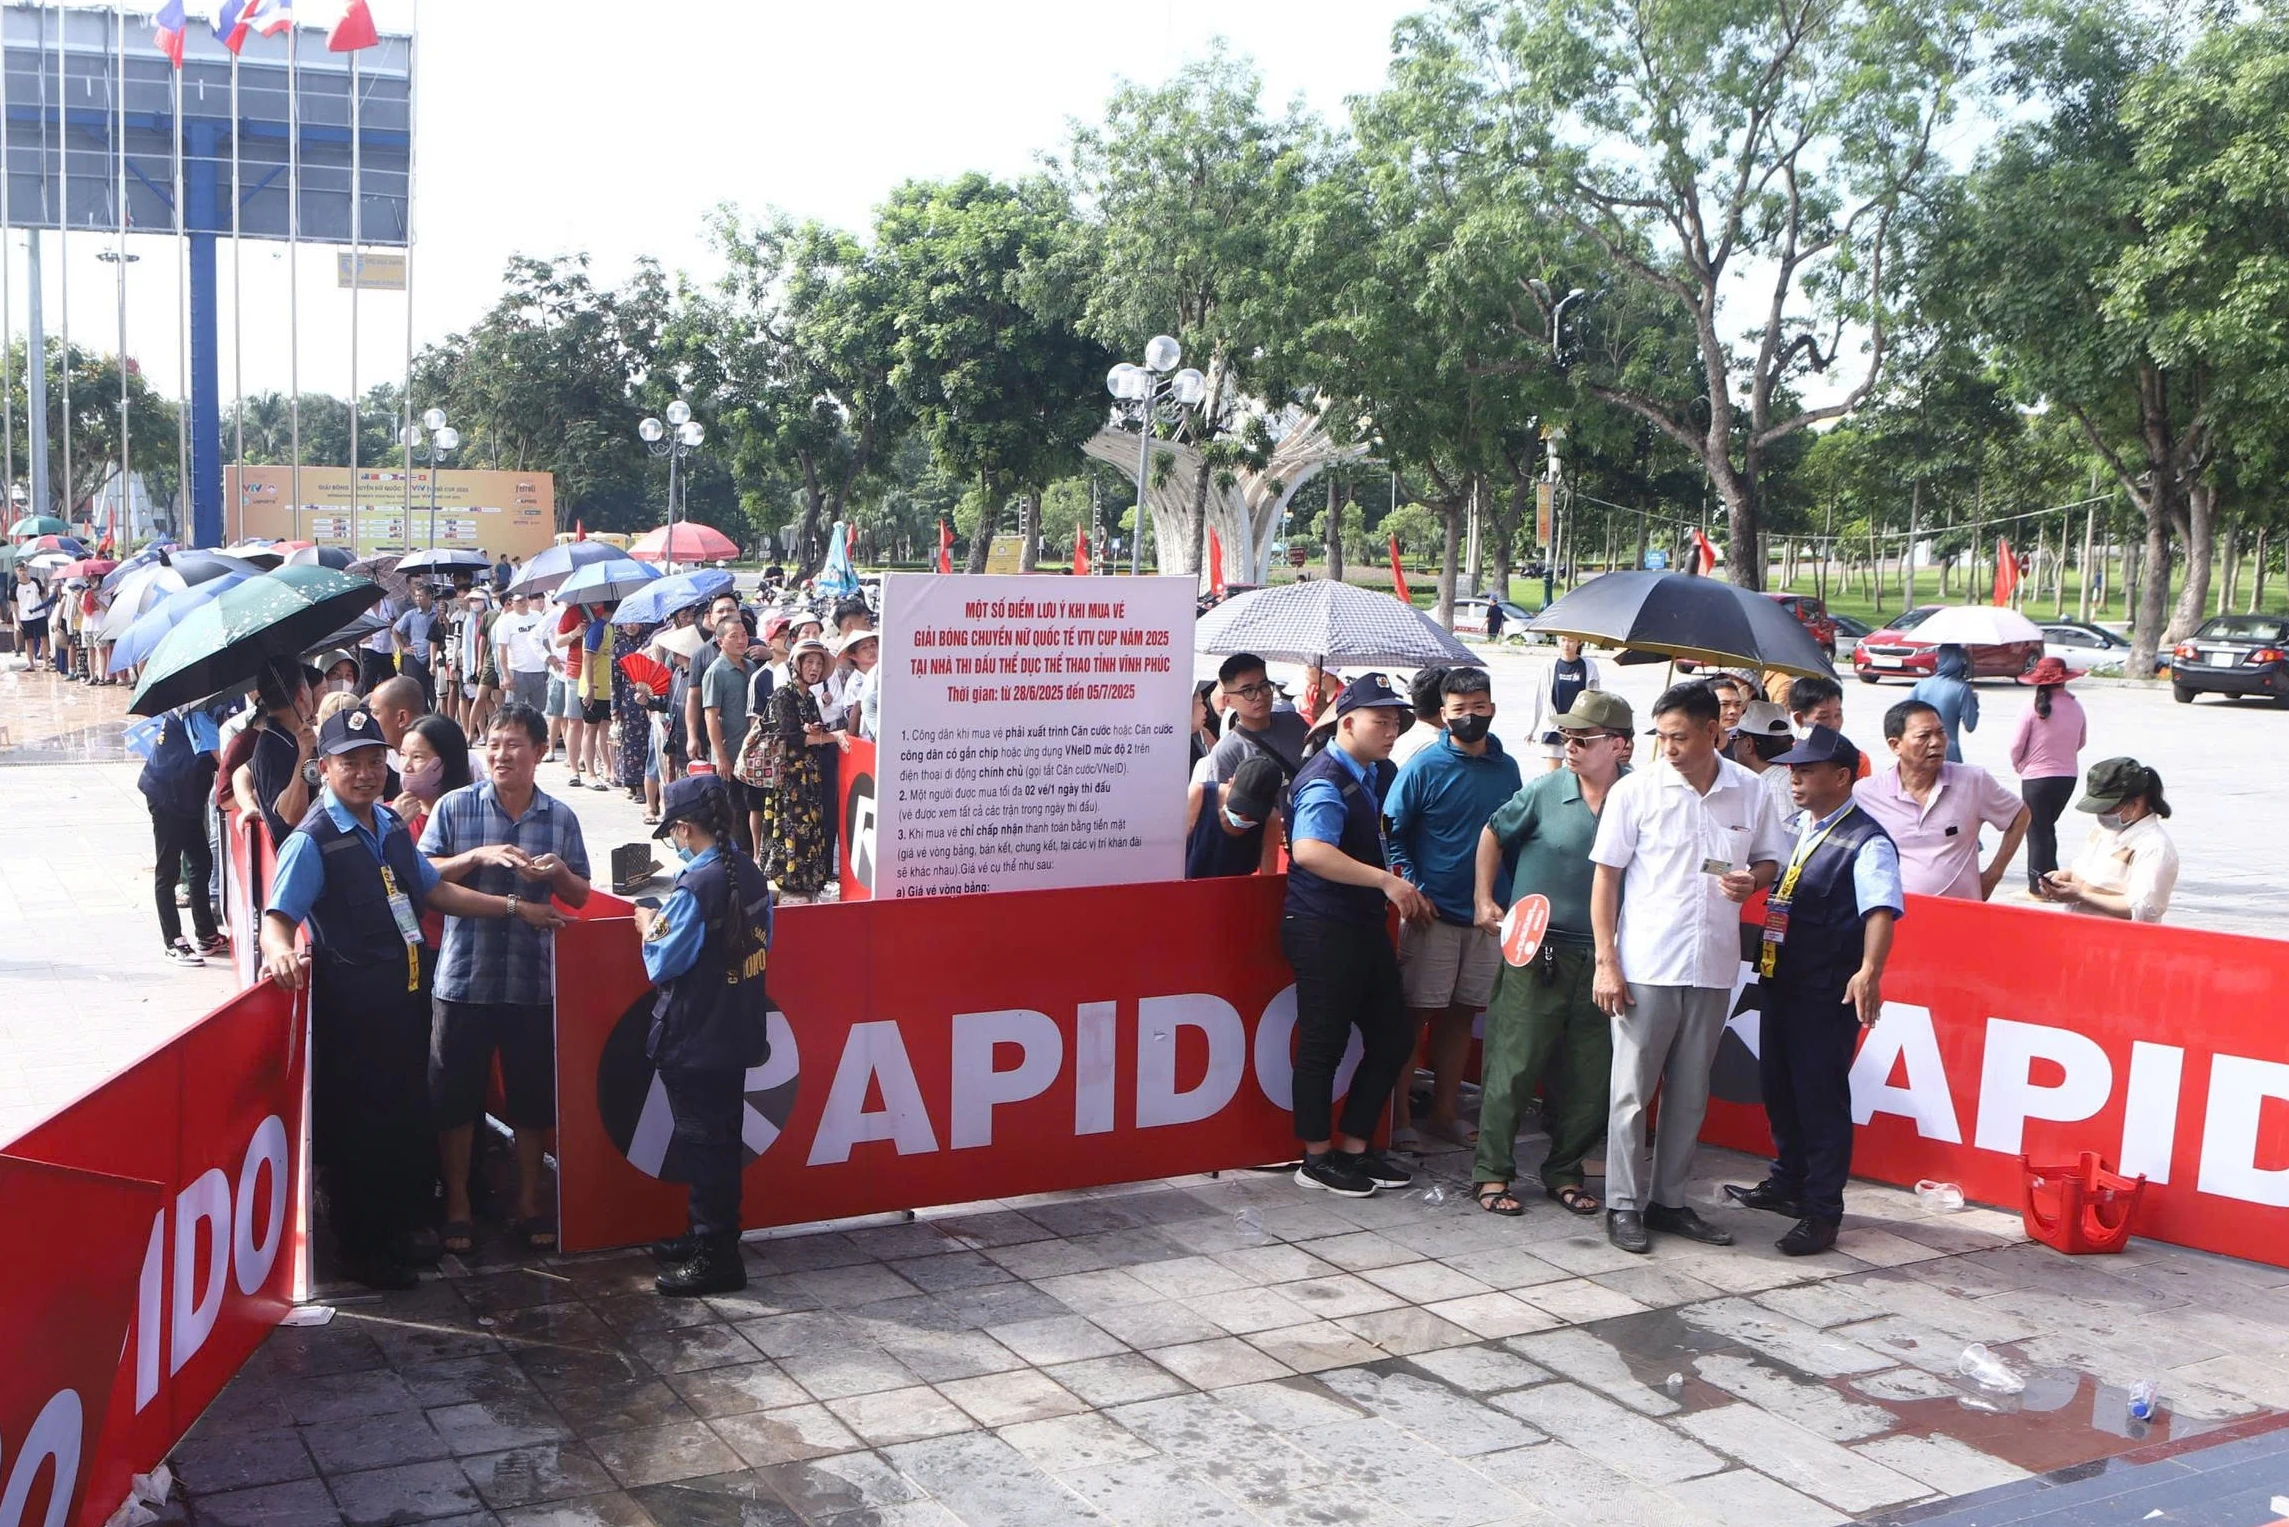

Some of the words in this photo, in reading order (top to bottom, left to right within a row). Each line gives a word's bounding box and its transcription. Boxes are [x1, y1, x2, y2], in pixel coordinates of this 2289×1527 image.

[965, 599, 988, 621] MỘT
[991, 596, 1006, 618] SỐ
[1008, 596, 1034, 618] ĐIỂM
[1037, 601, 1056, 618] LƯU
[1060, 600, 1066, 618] Ý
[1068, 603, 1085, 618] KHI
[1088, 603, 1110, 618] MUA
[1113, 600, 1125, 619] VÉ
[914, 625, 936, 647] GIẢI
[939, 627, 968, 646] BÓNG
[1015, 627, 1031, 646] NỮ
[1033, 625, 1060, 647] QUỐC
[1063, 625, 1076, 646] TẾ
[1077, 630, 1095, 646] VTV
[1097, 630, 1117, 646] CUP
[1120, 627, 1143, 646] NĂM
[1145, 630, 1169, 646] 2025
[911, 659, 927, 679] TẠI
[930, 655, 952, 674] NHÀ
[956, 658, 971, 674] THI
[975, 652, 996, 674] ĐẤU
[999, 651, 1017, 673] THỂ
[1021, 658, 1041, 677] DỤC
[1044, 651, 1063, 673] THỂ
[1066, 657, 1090, 673] THAO
[1094, 652, 1116, 673] TỈNH
[1119, 654, 1141, 672] VĨNH
[1144, 654, 1170, 672] PHÚC
[947, 685, 969, 702] Thời
[972, 685, 998, 703] gian:
[1001, 685, 1011, 701] từ
[1013, 685, 1063, 701] 28/6/2025
[1066, 681, 1084, 700] đến
[1087, 684, 1135, 700] 05/7/2025
[901, 730, 909, 741] 1.
[912, 729, 935, 743] Công
[938, 728, 954, 740] dân
[957, 728, 969, 739] khi
[972, 730, 990, 739] mua
[993, 728, 1003, 738] vé
[1005, 725, 1024, 740] phải
[1027, 725, 1046, 738] xuất
[1048, 726, 1068, 737] trình
[1071, 725, 1088, 736] Căn
[1090, 725, 1111, 736] cước
[1113, 725, 1132, 737] hoặc
[1134, 724, 1151, 735] Căn
[1154, 724, 1173, 734] cước
[901, 750, 923, 763] công
[926, 749, 943, 760] dân
[946, 748, 957, 759] có
[960, 746, 976, 761] gắn
[979, 747, 998, 760] chip
[1001, 747, 1021, 759] hoặc
[1024, 746, 1039, 759] ứng
[1042, 746, 1062, 759] dụng
[1065, 745, 1091, 755] VNeID
[1094, 743, 1112, 755] mức
[1114, 743, 1125, 756] độ
[1127, 744, 1132, 754] 2
[1134, 743, 1150, 754] trên
[900, 770, 918, 781] điện
[921, 769, 942, 780] thoại
[945, 768, 952, 779] di
[955, 768, 976, 781] động
[979, 766, 1004, 778] chính
[1006, 765, 1023, 777] chủ
[1026, 766, 1040, 779] (gọi
[1044, 763, 1054, 775] tắt
[1056, 764, 1073, 775] Căn
[899, 790, 907, 801] 2.
[910, 789, 926, 802] Một
[929, 789, 952, 802] người
[955, 788, 976, 800] được
[978, 788, 997, 798] mua
[1000, 784, 1010, 796] tối
[1012, 785, 1023, 796] đa
[1025, 785, 1035, 796] 02
[1038, 784, 1055, 795] vé/1
[1058, 783, 1079, 796] ngày
[1081, 783, 1092, 793] thi
[1095, 781, 1111, 793] đấu
[899, 809, 912, 822] (vé
[915, 809, 936, 820] được
[939, 809, 957, 818] xem
[960, 804, 971, 818] tất
[973, 804, 983, 817] cả
[985, 805, 1000, 816] các
[1002, 805, 1019, 817] trận
[1021, 805, 1042, 816] trong
[1045, 803, 1065, 816] ngày
[1067, 802, 1077, 812] thi
[1079, 800, 1100, 813] đấu).
[898, 829, 906, 840] 3.
[909, 828, 924, 840] Khi
[926, 829, 945, 839] mua
[947, 826, 957, 837] vé
[960, 824, 974, 837] chỉ
[976, 823, 998, 837] chấp
[1001, 823, 1023, 836] nhận
[1025, 823, 1048, 834] thanh
[1051, 822, 1069, 832] toán
[1071, 819, 1091, 833] bằng
[1111, 819, 1126, 831] mặt
[897, 848, 914, 861] (giá
[916, 847, 926, 858] vé
[929, 846, 950, 859] vòng
[953, 844, 977, 858] bảng,
[980, 844, 995, 854] bán
[998, 841, 1012, 854] kết,
[1015, 842, 1041, 854] chung
[1043, 839, 1058, 852] kết,
[1060, 840, 1070, 852] tại
[1072, 839, 1087, 850] các
[1089, 840, 1096, 851] vị
[1098, 837, 1106, 849] trí
[1108, 837, 1127, 848] khán
[1129, 836, 1141, 847] đài
[897, 867, 907, 878] sẽ
[910, 866, 931, 877] khác
[978, 862, 988, 873] vé
[991, 863, 1000, 874] cụ
[1003, 858, 1016, 871] thể
[1018, 860, 1034, 870] như
[1036, 860, 1054, 870] sau:
[896, 887, 905, 898] a)
[908, 884, 923, 897] Giá
[926, 884, 936, 895] vé
[940, 883, 961, 894] vòng
[964, 881, 990, 893] bảng:
